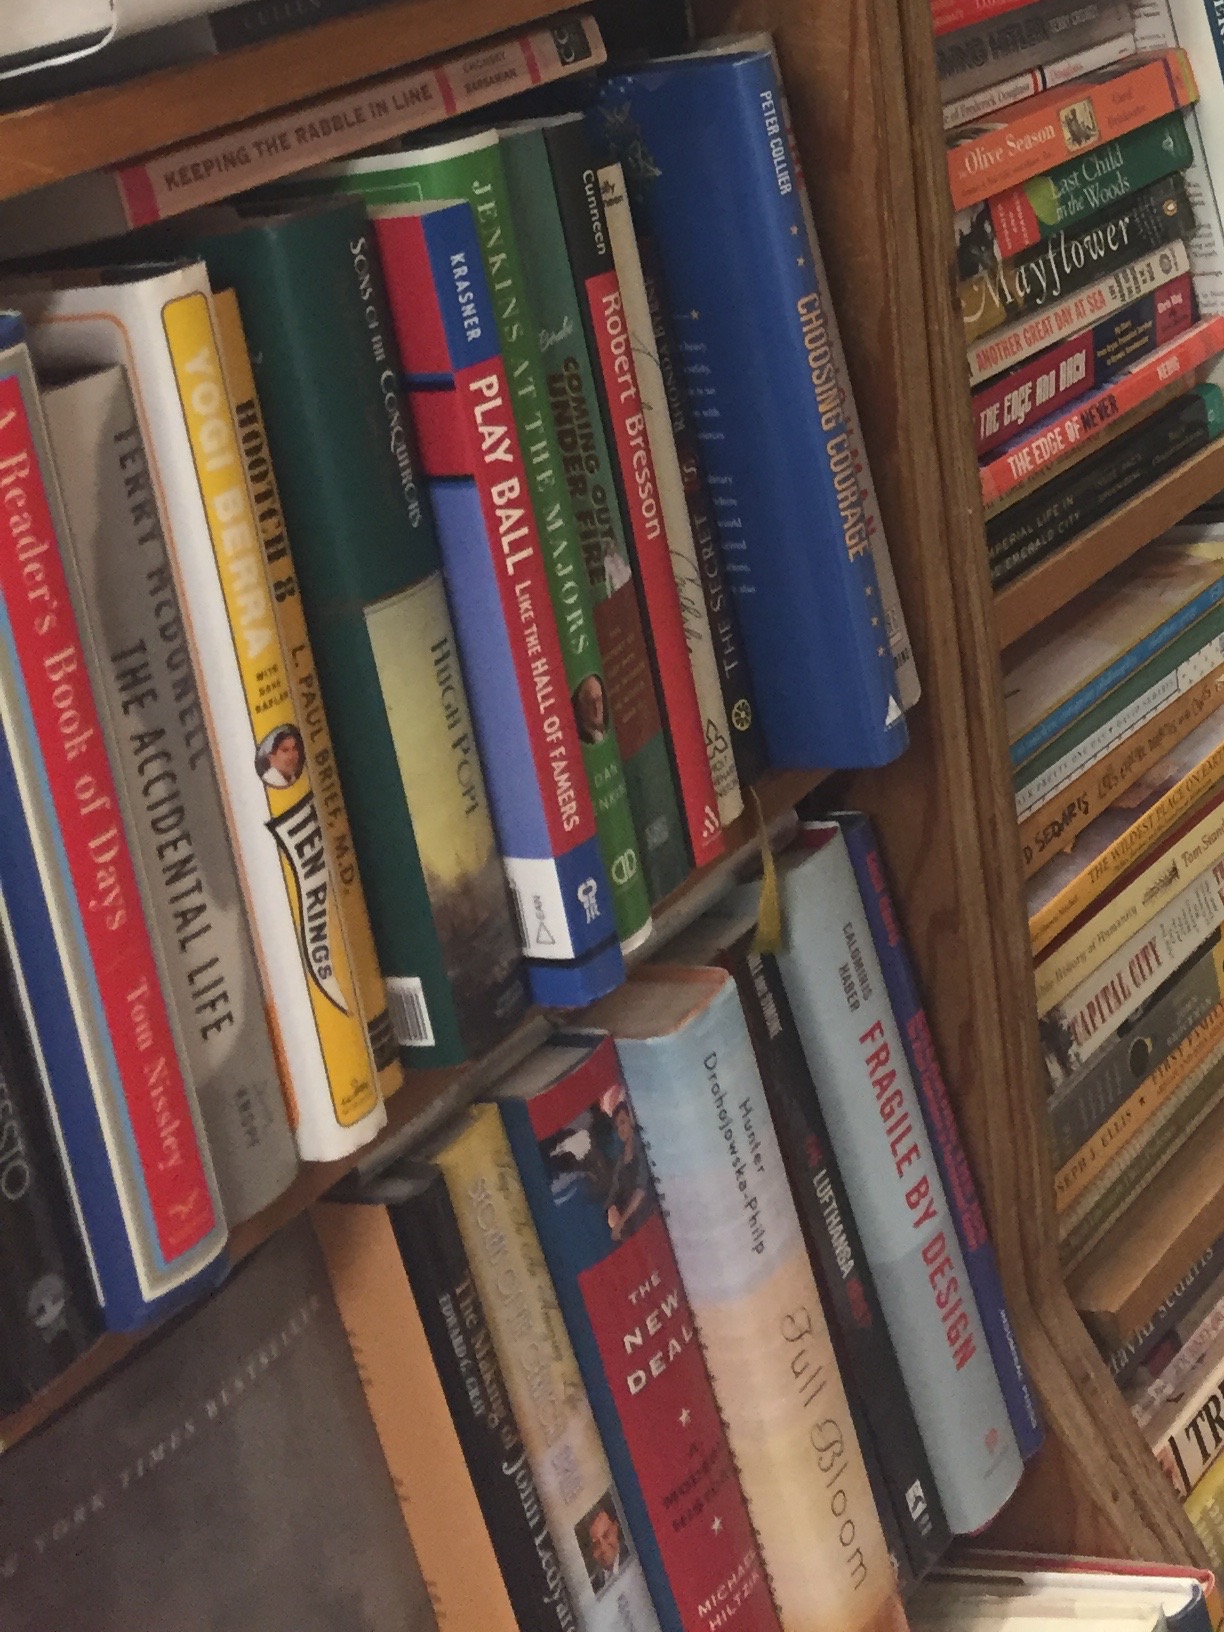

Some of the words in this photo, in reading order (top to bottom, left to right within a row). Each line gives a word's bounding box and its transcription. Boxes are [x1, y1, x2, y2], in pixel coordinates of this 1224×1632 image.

[164, 144, 251, 193] KEEPING
[254, 130, 292, 157] THE
[294, 106, 364, 149] RABBLE
[369, 100, 389, 124] IN
[391, 82, 434, 116] LINE
[759, 91, 782, 138] PETER
[771, 136, 793, 196] COLLIER
[965, 142, 1004, 175] Olive
[1006, 125, 1056, 158] Season
[450, 253, 482, 344] KRASNER
[471, 180, 524, 345] JENKINS
[963, 215, 1130, 323] Mayflower
[975, 331, 1023, 371] ANOTHER
[1023, 319, 1051, 350] GREAT
[1087, 289, 1107, 316] SEA
[469, 374, 513, 464] PLAY
[512, 356, 538, 401] AT
[601, 292, 638, 403] Robert
[624, 409, 660, 541] Bresson
[524, 409, 555, 494] THE
[798, 292, 844, 431] CHOOSING
[825, 436, 870, 564] COURAGE
[1007, 448, 1031, 480] THE
[1032, 430, 1065, 468] EDGE
[1066, 416, 1082, 448] OF
[185, 349, 233, 470] YOGI
[213, 492, 276, 660] BERRA
[490, 476, 531, 575] BALL
[513, 580, 533, 622] LIKE
[543, 502, 590, 656] MAJORS
[521, 622, 542, 654] THE
[43, 647, 97, 759] Book
[529, 654, 558, 715] HALL
[541, 717, 562, 740] OF
[74, 777, 112, 815] of
[285, 793, 325, 866] TEN
[548, 742, 581, 833] FAMERS
[1033, 791, 1090, 853] SEDARIS
[87, 828, 128, 932] Days
[109, 639, 150, 717] THE
[130, 729, 213, 952] ACCIDENTAL
[185, 956, 234, 1043] LIFE
[1180, 846, 1203, 868] Tom
[302, 881, 334, 982] RINGS
[1130, 937, 1163, 988] CITY
[125, 977, 164, 1049] Tom
[838, 960, 861, 1013] HABER
[141, 1057, 186, 1171] Nissley
[738, 1098, 768, 1177] Hunter
[859, 1019, 922, 1178] FRAGILE
[905, 1177, 938, 1229] BY
[922, 1234, 976, 1372] DESIGN
[623, 1290, 681, 1355] NEW
[629, 1270, 661, 1305] THE
[627, 1323, 693, 1396] DEAL
[812, 1420, 869, 1592] Bloom
